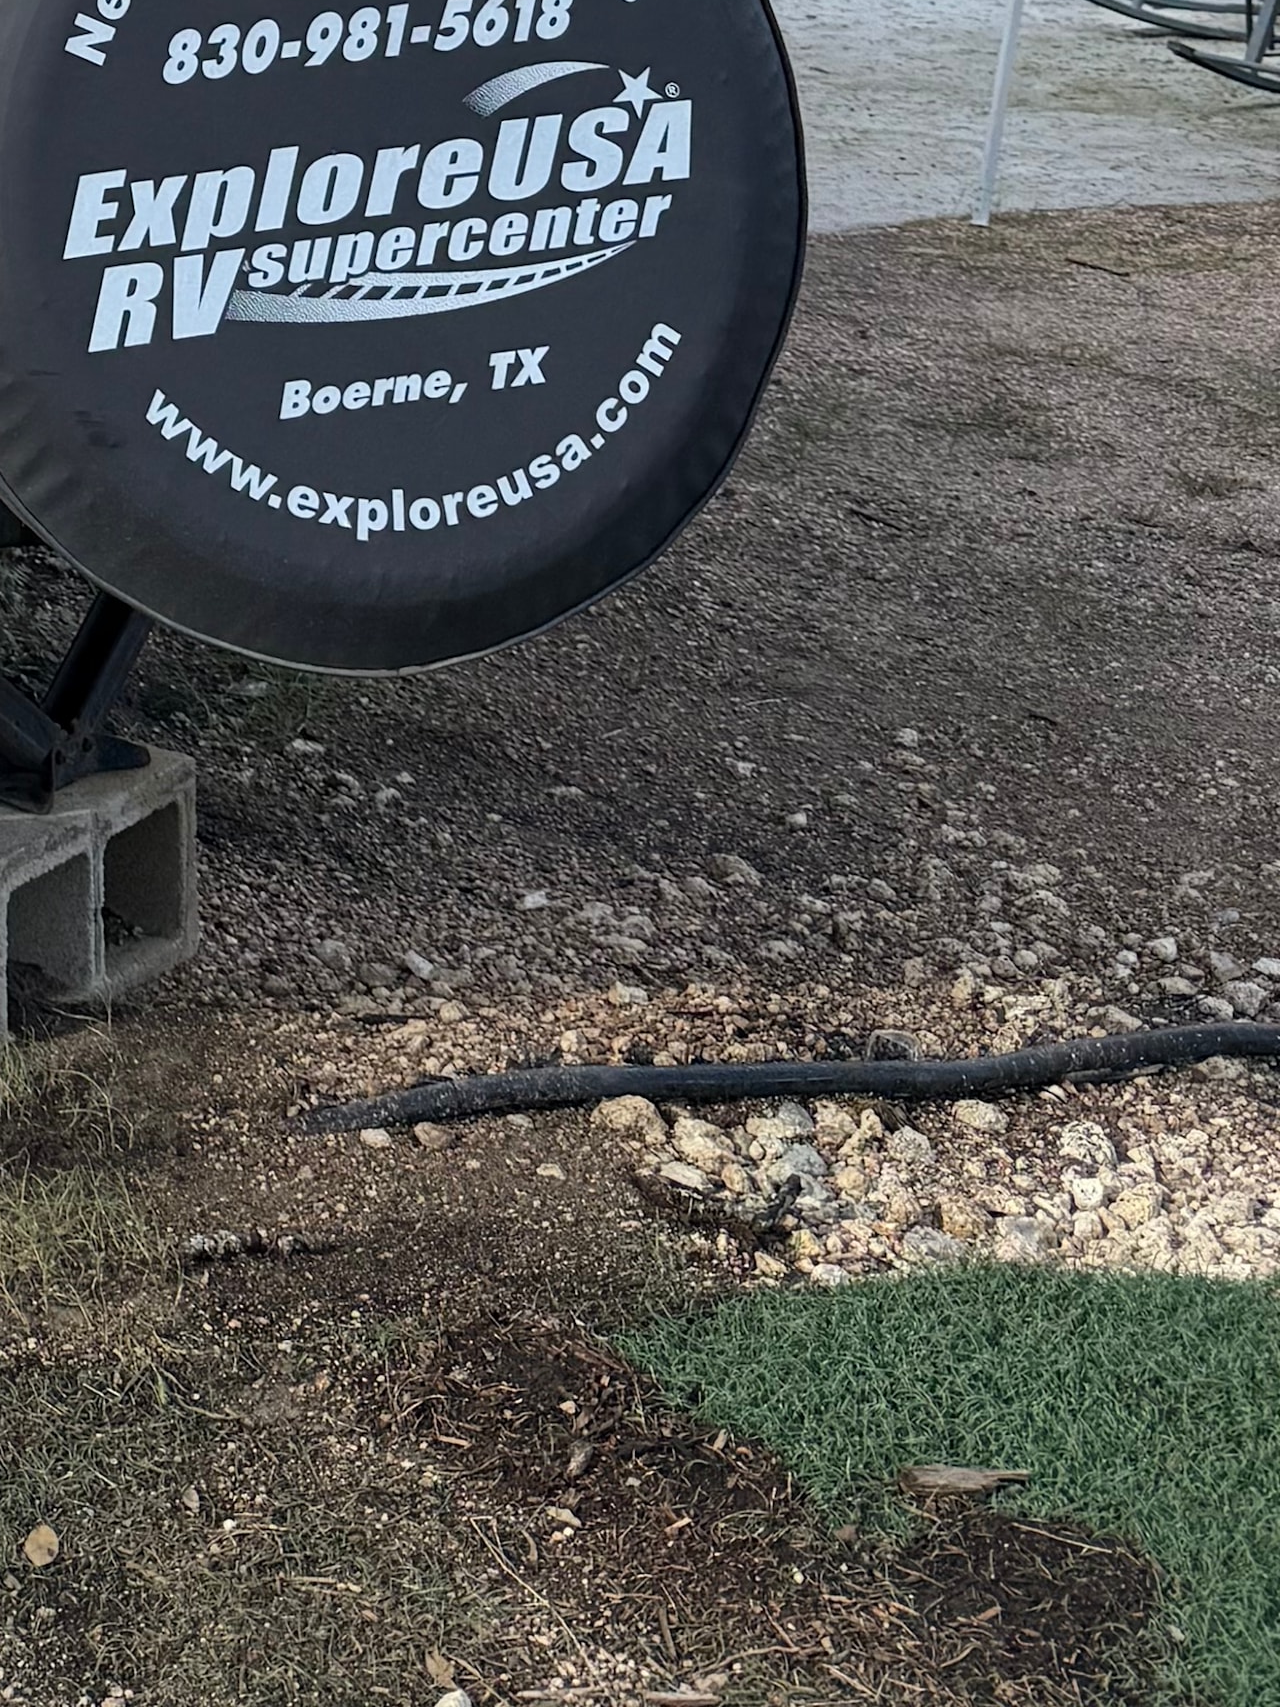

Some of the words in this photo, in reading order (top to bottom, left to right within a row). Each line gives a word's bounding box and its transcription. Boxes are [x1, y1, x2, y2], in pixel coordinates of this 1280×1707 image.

[88, 247, 246, 353] RV
[248, 193, 673, 289] supercenter
[144, 323, 682, 541] www.exploreusa.com
[279, 370, 468, 420] Boerne,
[489, 345, 550, 390] TX
